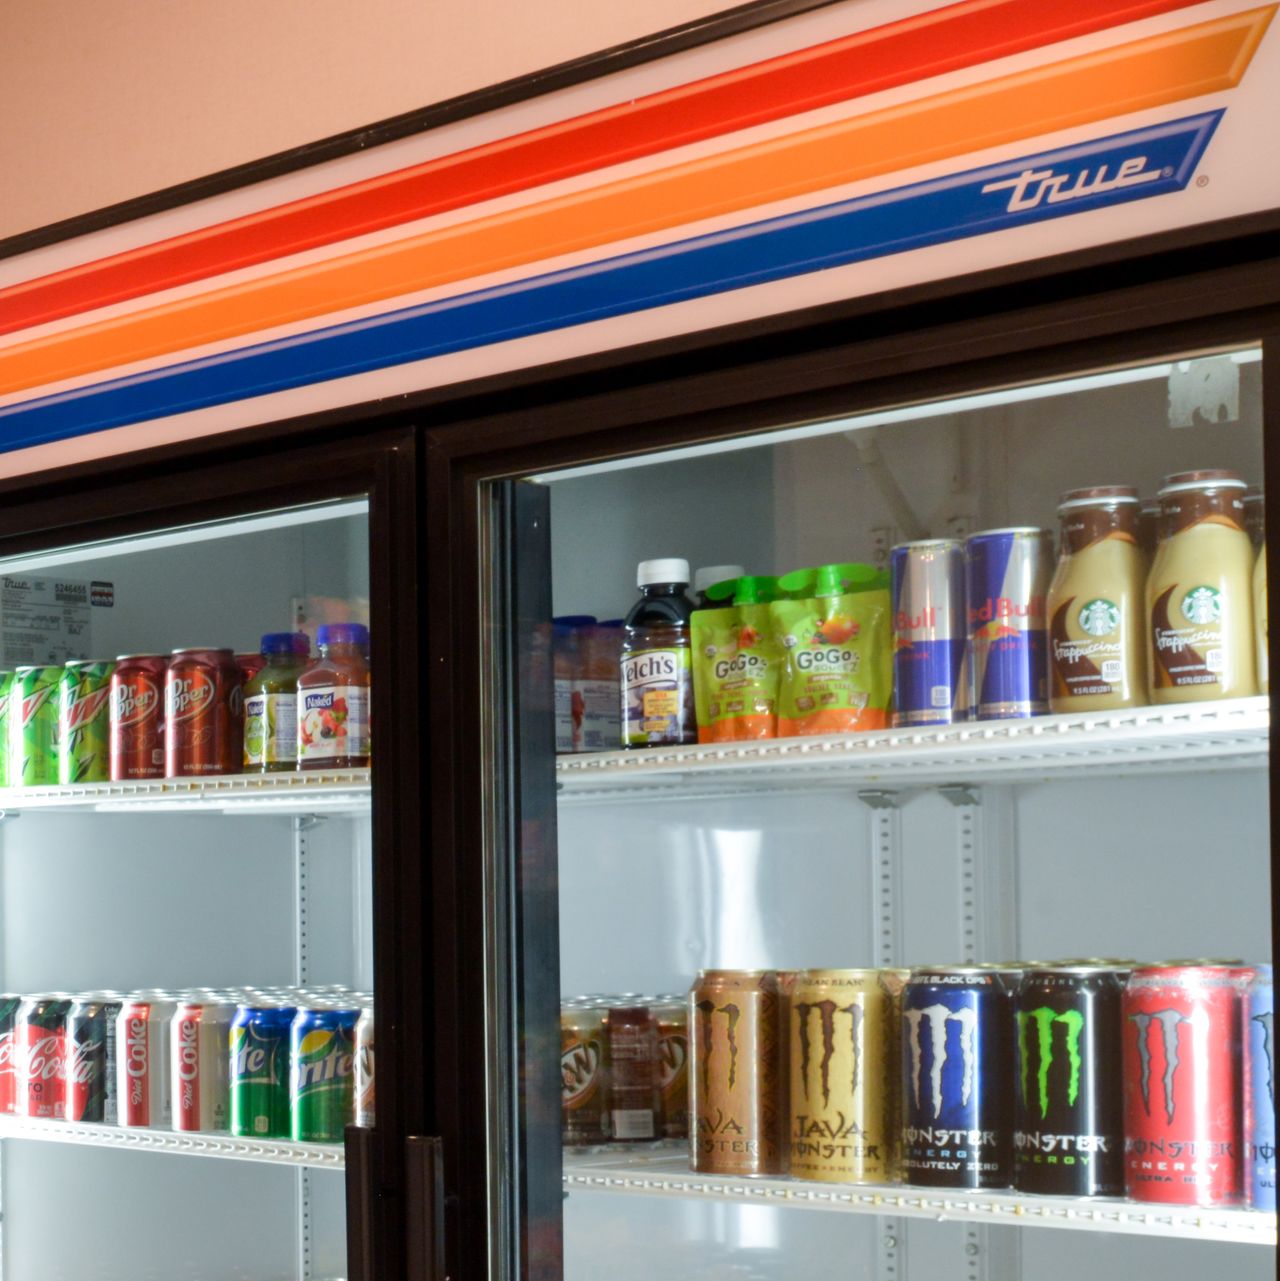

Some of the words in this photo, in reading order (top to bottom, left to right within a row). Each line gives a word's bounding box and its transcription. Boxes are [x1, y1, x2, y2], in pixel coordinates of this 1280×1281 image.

[895, 608, 937, 631] Bull
[307, 693, 332, 708] Naked
[931, 976, 964, 984] BLACK
[127, 1018, 147, 1078] Coke
[795, 1111, 868, 1141] JAVA
[967, 1162, 999, 1171] ZERO
